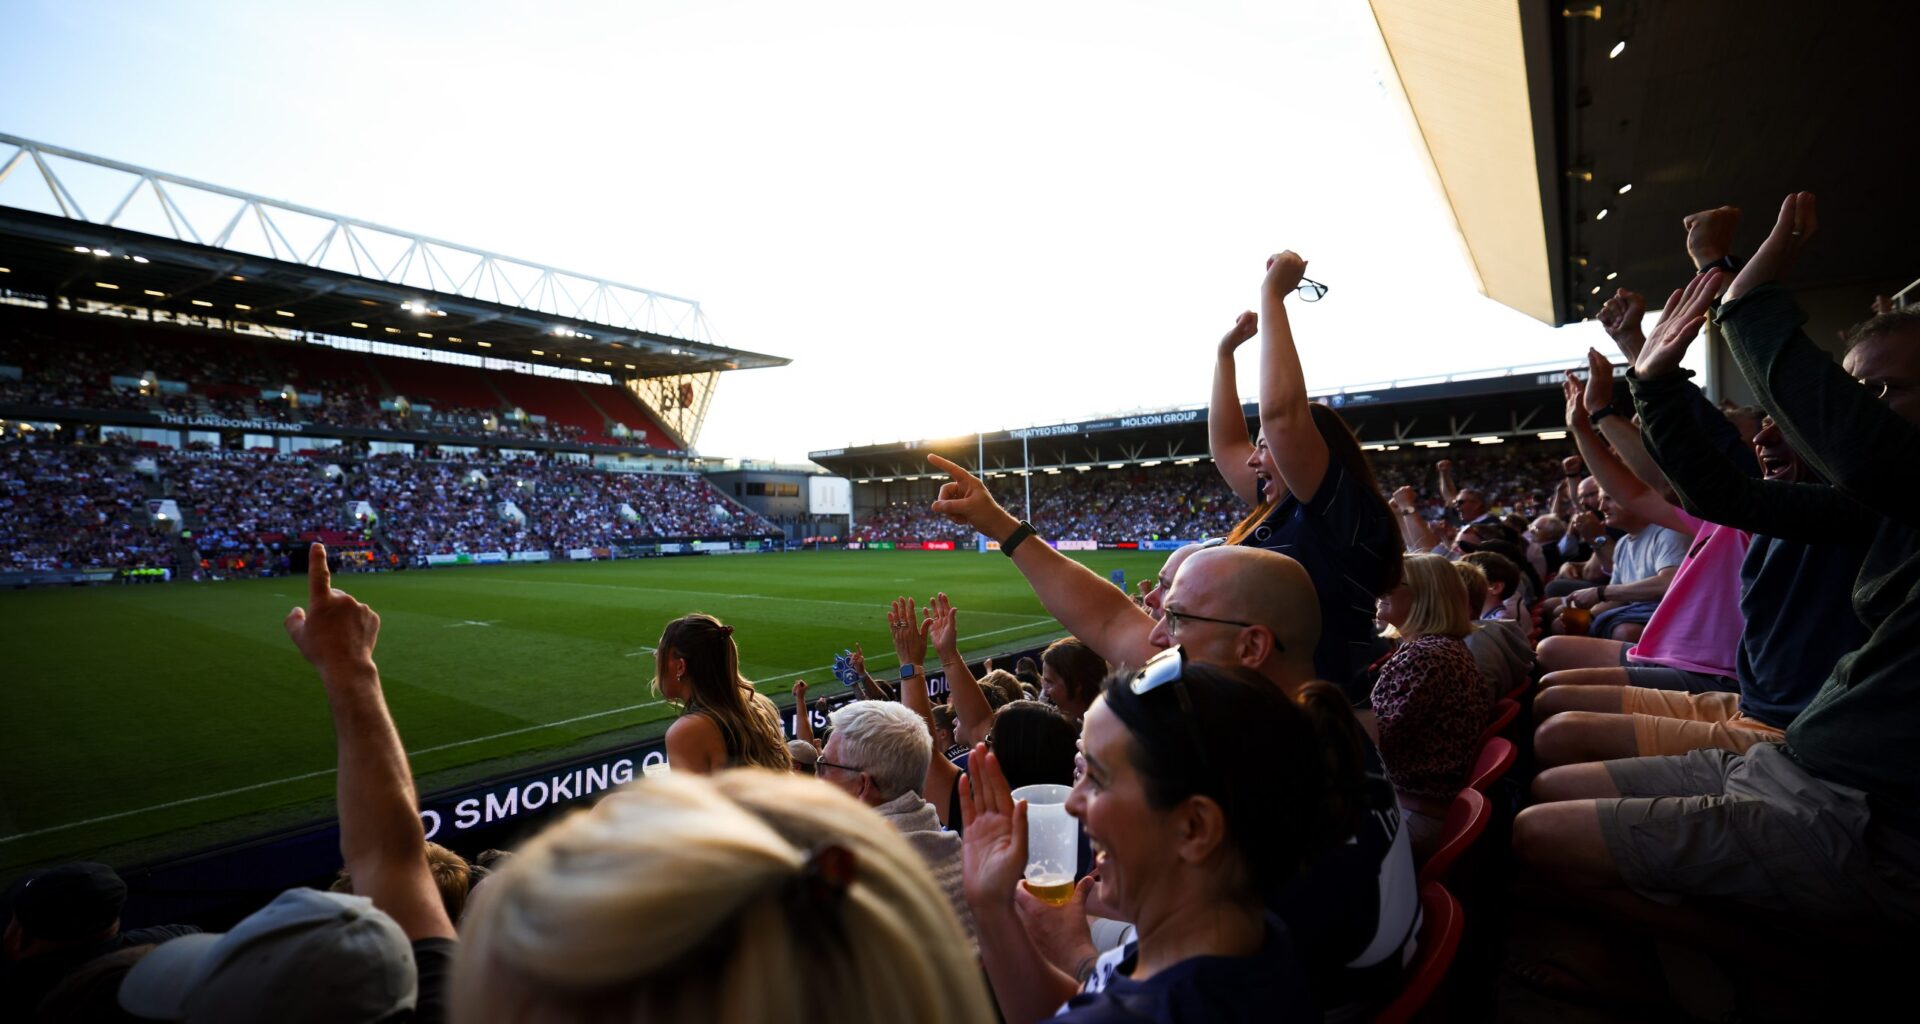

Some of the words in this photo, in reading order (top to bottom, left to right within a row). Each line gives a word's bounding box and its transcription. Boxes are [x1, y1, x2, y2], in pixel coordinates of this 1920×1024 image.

[160, 415, 185, 425] THE
[188, 416, 262, 430] LANSDOWN
[263, 421, 304, 432] STAND
[422, 414, 477, 425] KAELO
[1121, 415, 1162, 428] MOLSON
[1163, 411, 1198, 424] GROUP
[1010, 429, 1025, 439] THE
[1025, 426, 1051, 438] ATYEO
[1052, 424, 1079, 436] STAND
[419, 809, 441, 841] O
[454, 759, 633, 830] SMOKING
